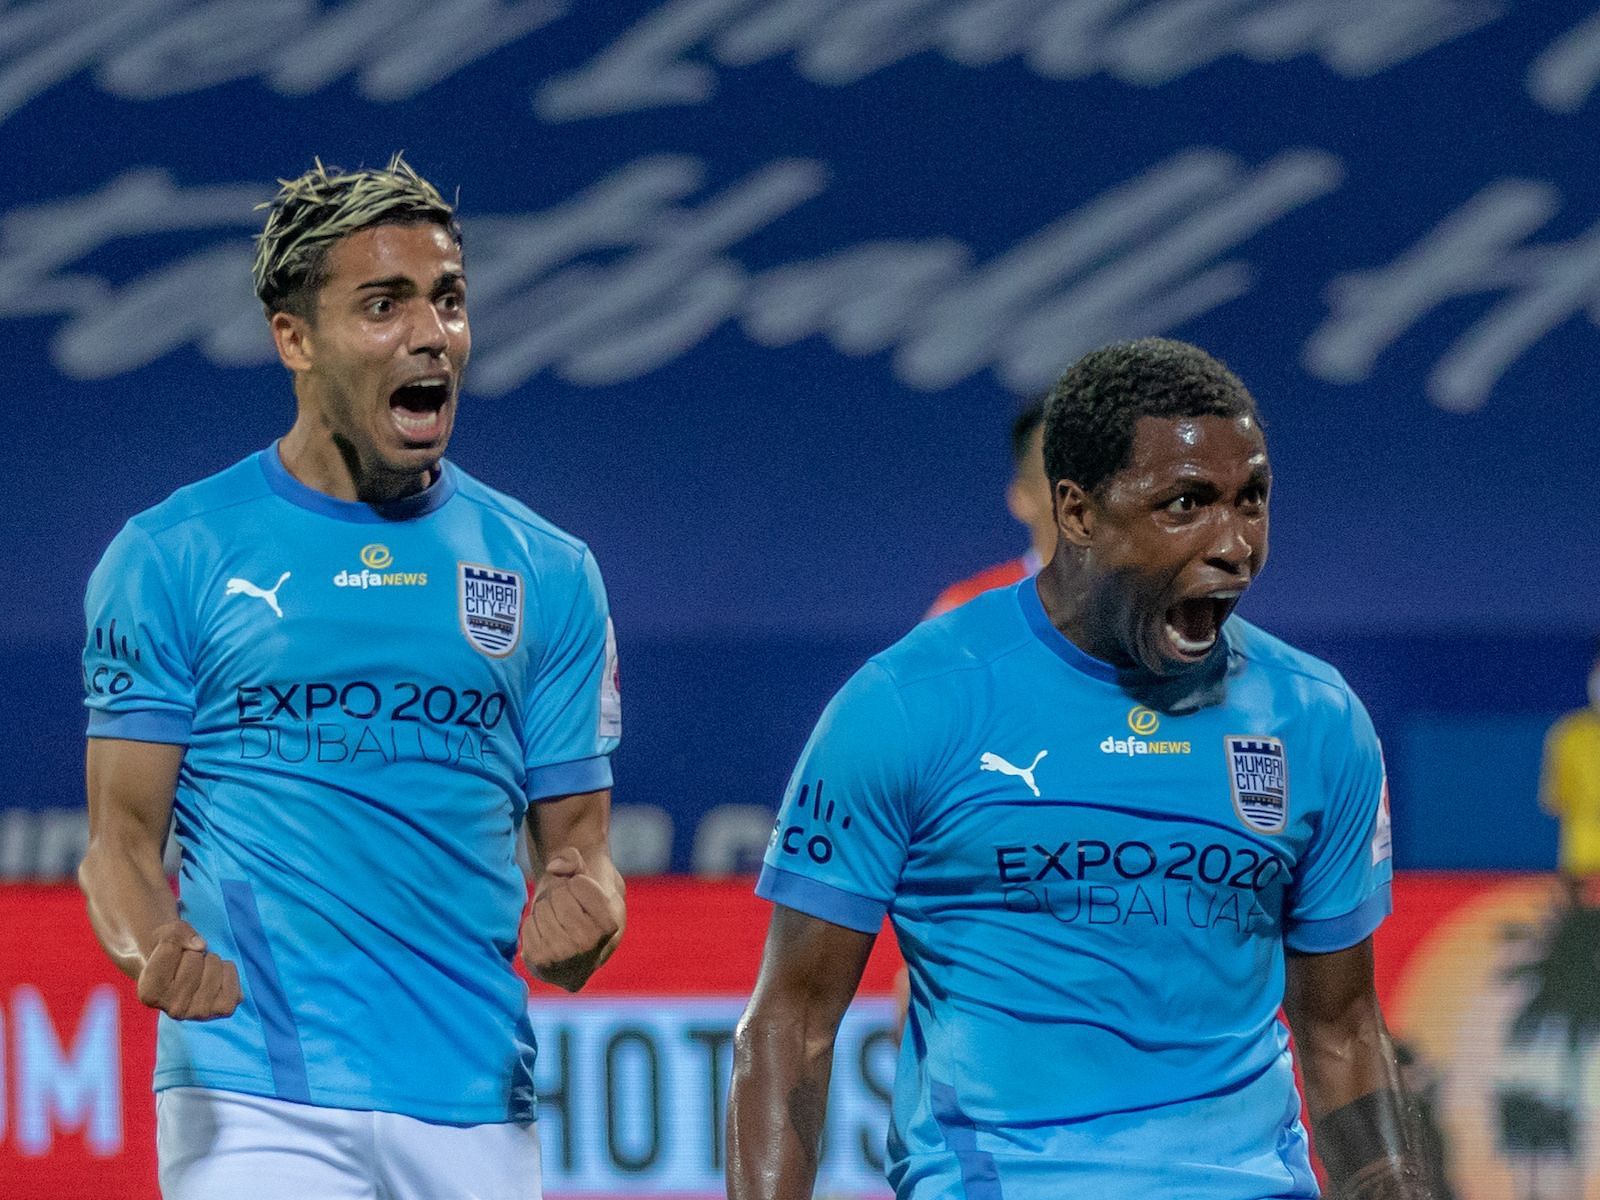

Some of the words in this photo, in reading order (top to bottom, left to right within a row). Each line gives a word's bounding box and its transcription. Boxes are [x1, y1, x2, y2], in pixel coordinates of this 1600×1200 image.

[333, 570, 428, 589] dafaNEWS
[465, 580, 517, 604] MUMBAI
[466, 597, 496, 617] CITY
[498, 602, 516, 616] FC
[237, 680, 382, 725] EXPO
[391, 682, 507, 730] 2020
[239, 723, 399, 764] DUBAI
[1100, 736, 1191, 757] dafaNEWS
[1233, 755, 1283, 778] MUMBAI
[1236, 773, 1266, 791] CITY
[1268, 776, 1284, 789] FC
[996, 840, 1157, 883] EXPO
[1164, 842, 1283, 892] 2020
[1003, 884, 1168, 926] DUBAI
[0, 984, 124, 1156] M
